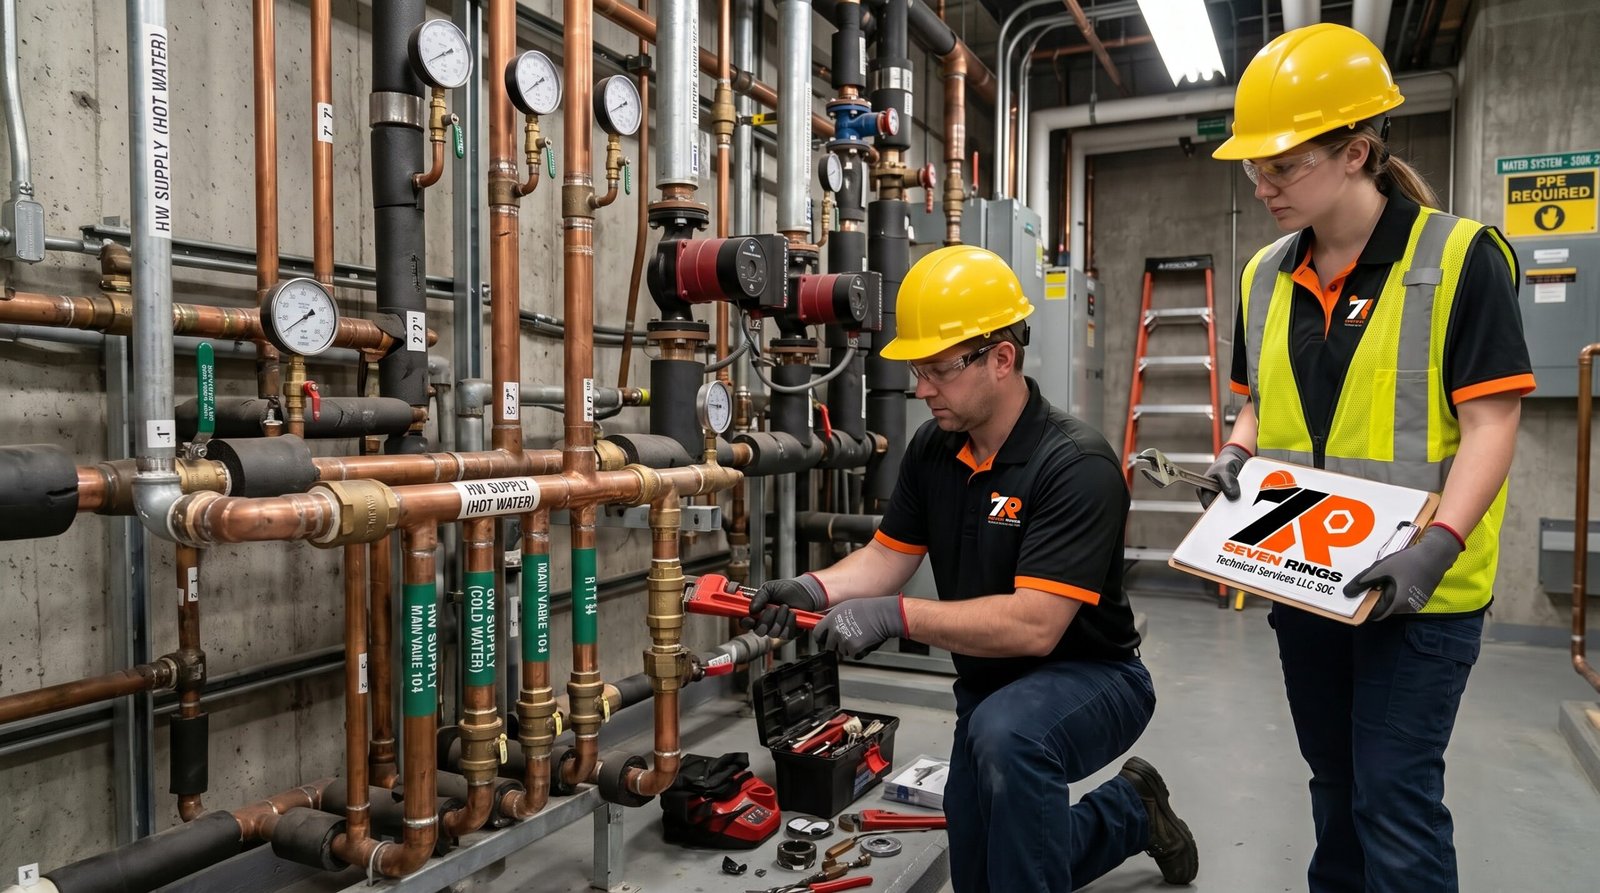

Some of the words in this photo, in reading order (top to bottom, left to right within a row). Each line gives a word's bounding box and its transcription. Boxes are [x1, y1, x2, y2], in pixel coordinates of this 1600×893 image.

[150, 33, 167, 91] WATER)
[152, 95, 168, 134] (HOT
[153, 140, 169, 200] SUPPLY
[1530, 157, 1563, 169] SYSTEM
[1536, 175, 1567, 188] PPE
[1511, 186, 1591, 203] REQUIRED
[155, 205, 170, 232] HW
[464, 483, 487, 496] HW
[487, 480, 530, 494] SUPPLY
[466, 498, 494, 516] (HOT
[496, 494, 535, 511] WATER)
[1216, 554, 1256, 574] Technical
[1256, 566, 1296, 585] Services
[1296, 576, 1315, 591] LLC
[1315, 581, 1336, 596] SOC
[1222, 542, 1283, 567] SEVEN
[1284, 558, 1343, 583] RINGS
[410, 605, 424, 635] MAIN
[427, 603, 437, 628] HW
[467, 585, 485, 622] (COLD
[468, 625, 484, 673] WATER)
[486, 614, 496, 668] SUPPLY
[427, 632, 437, 689] SUPPLY
